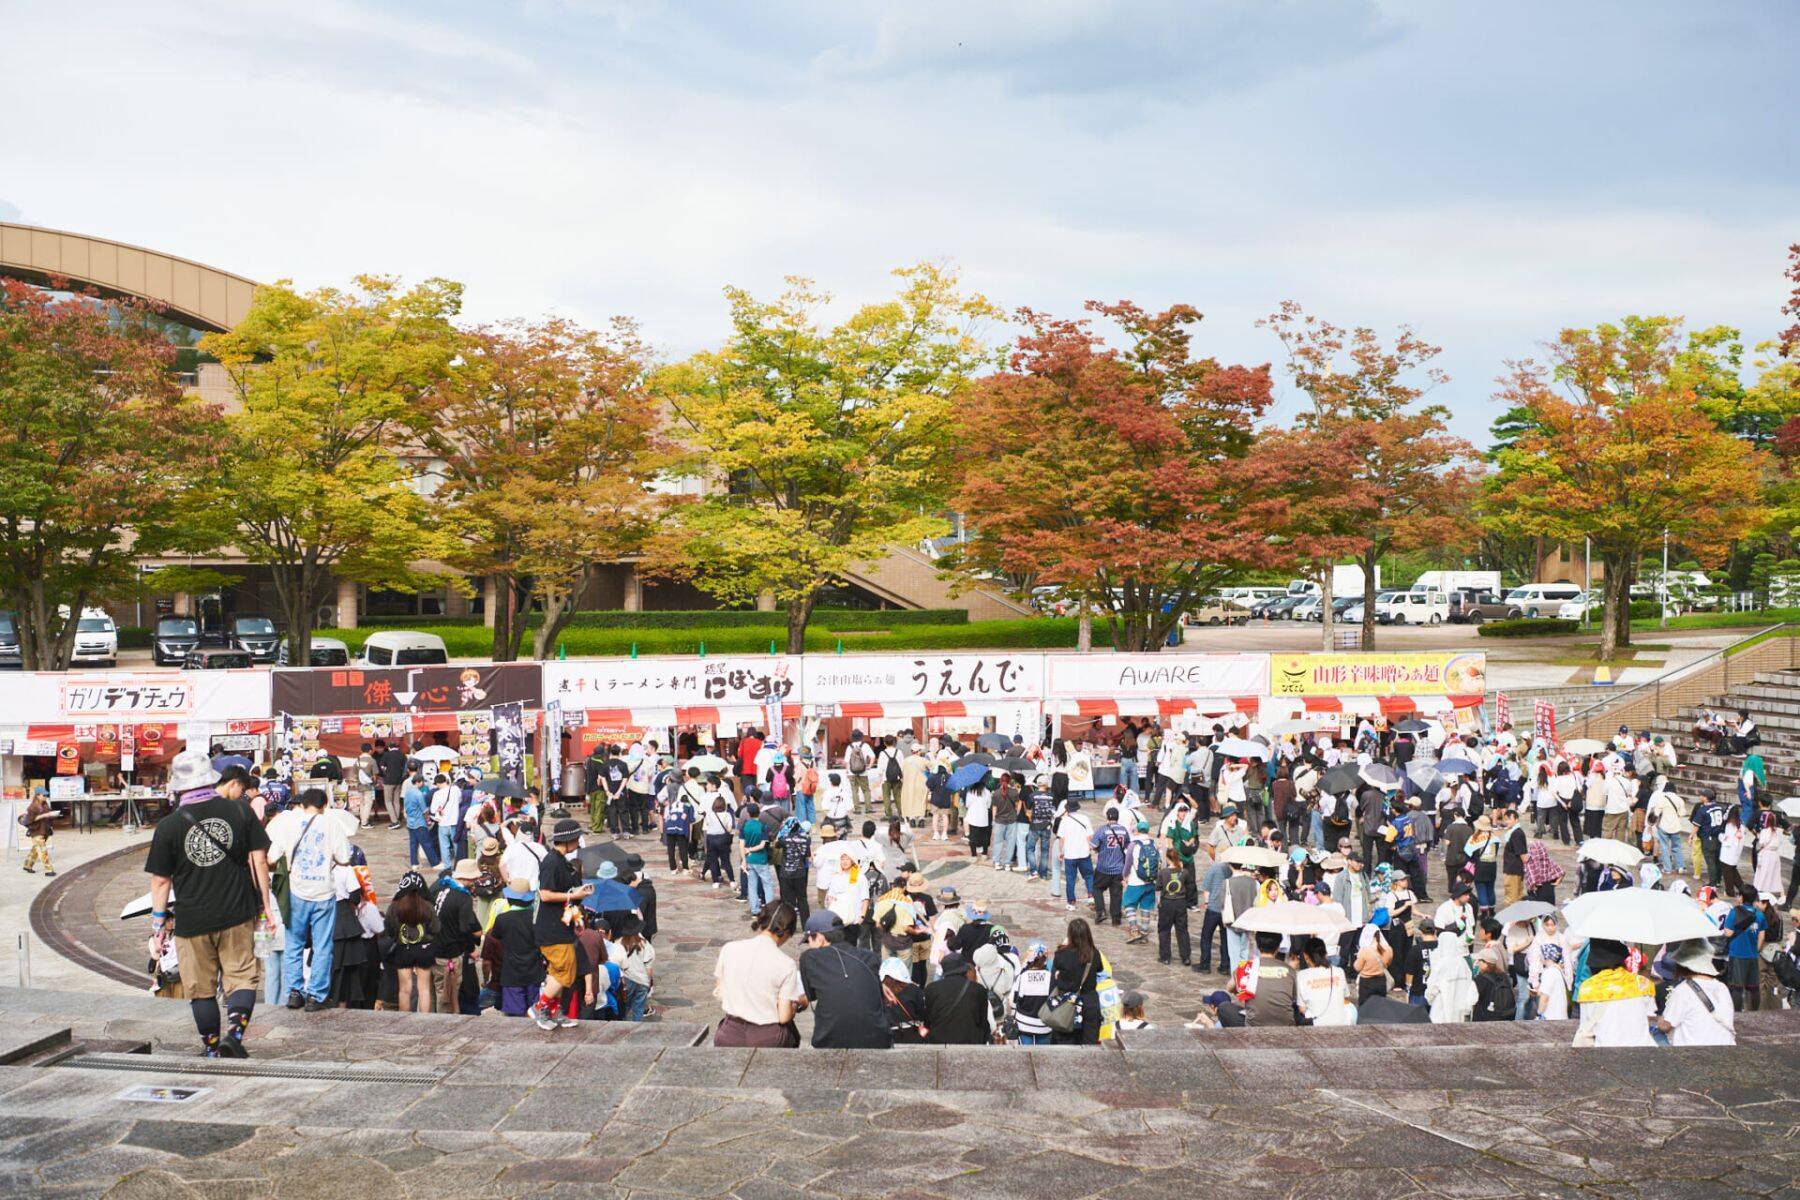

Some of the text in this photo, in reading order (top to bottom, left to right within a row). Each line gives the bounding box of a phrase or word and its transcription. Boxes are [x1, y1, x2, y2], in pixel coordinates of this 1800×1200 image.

[558, 675, 697, 692] 煮干しラーメン専門
[704, 669, 794, 700] にぼすけ
[912, 659, 1025, 696] うえんで
[1119, 665, 1201, 686] AWARE
[69, 686, 186, 710] ガリデブチュウ
[76, 723, 96, 738] 注文
